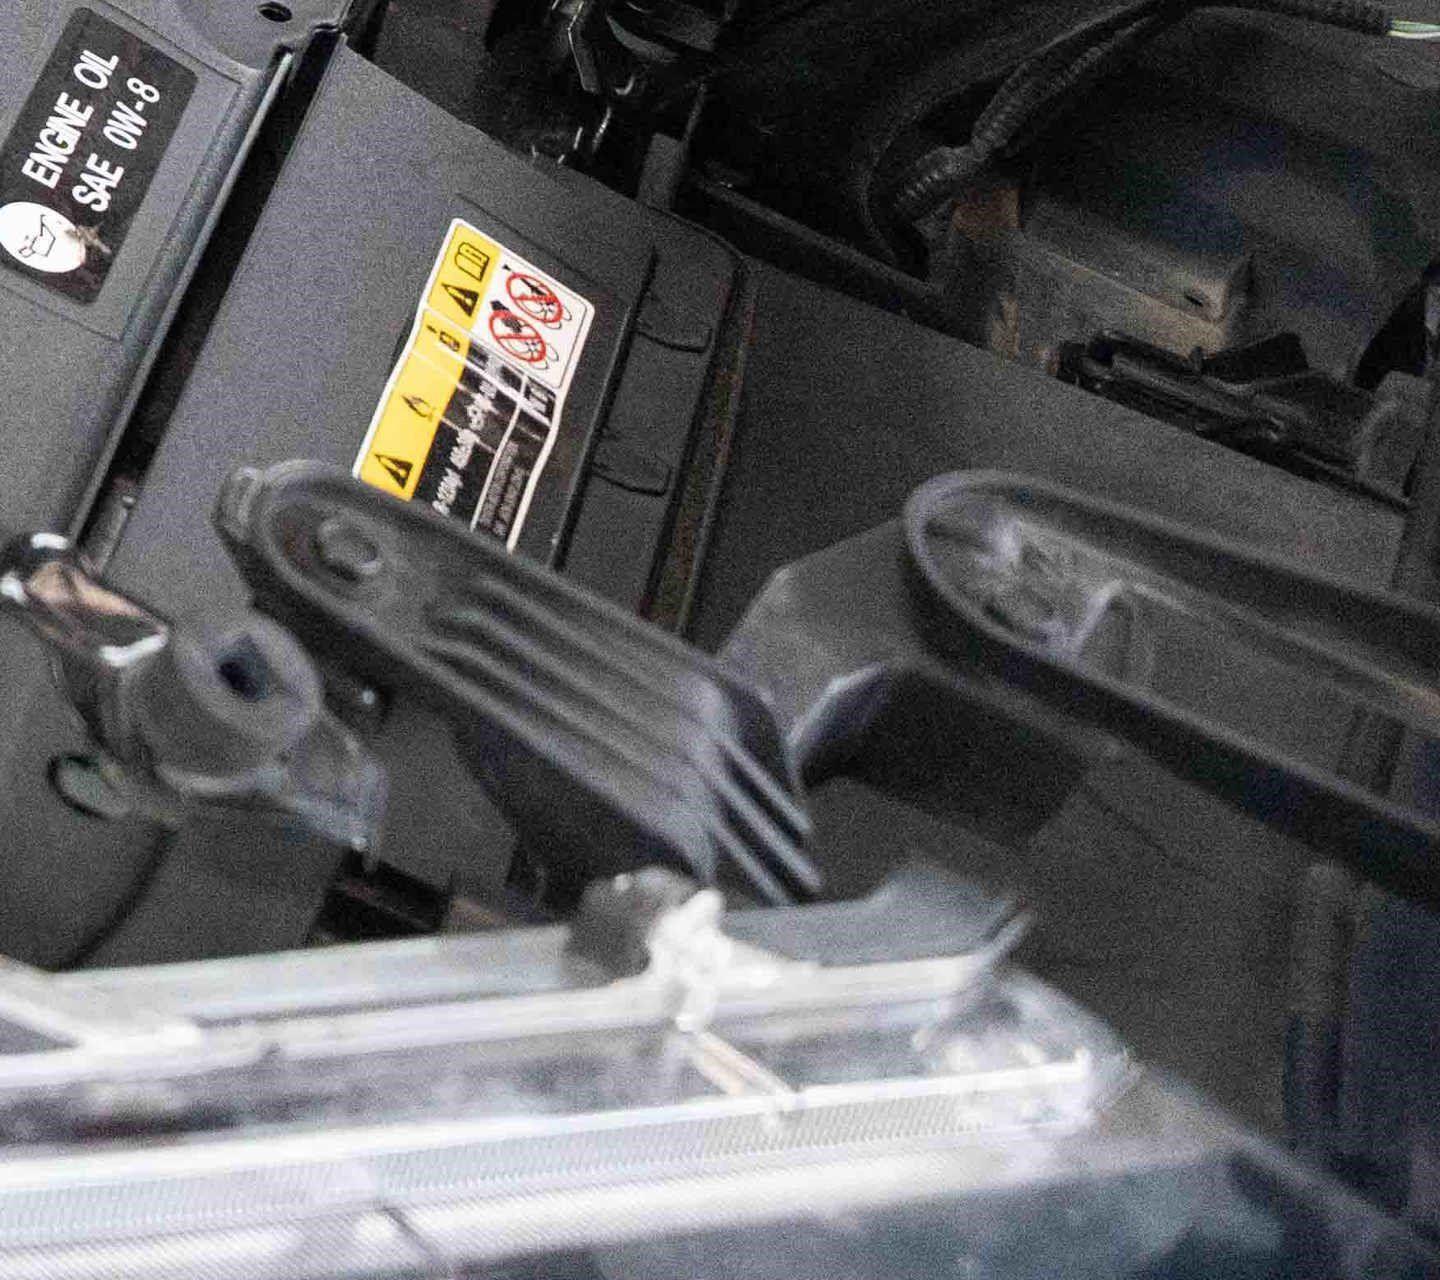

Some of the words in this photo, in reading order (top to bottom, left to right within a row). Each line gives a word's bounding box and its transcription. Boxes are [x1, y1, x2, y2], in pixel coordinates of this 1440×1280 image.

[21, 91, 94, 189] ENGINE
[73, 49, 120, 90] OIL
[71, 153, 124, 212] SAE
[102, 77, 161, 150] 0W-8
